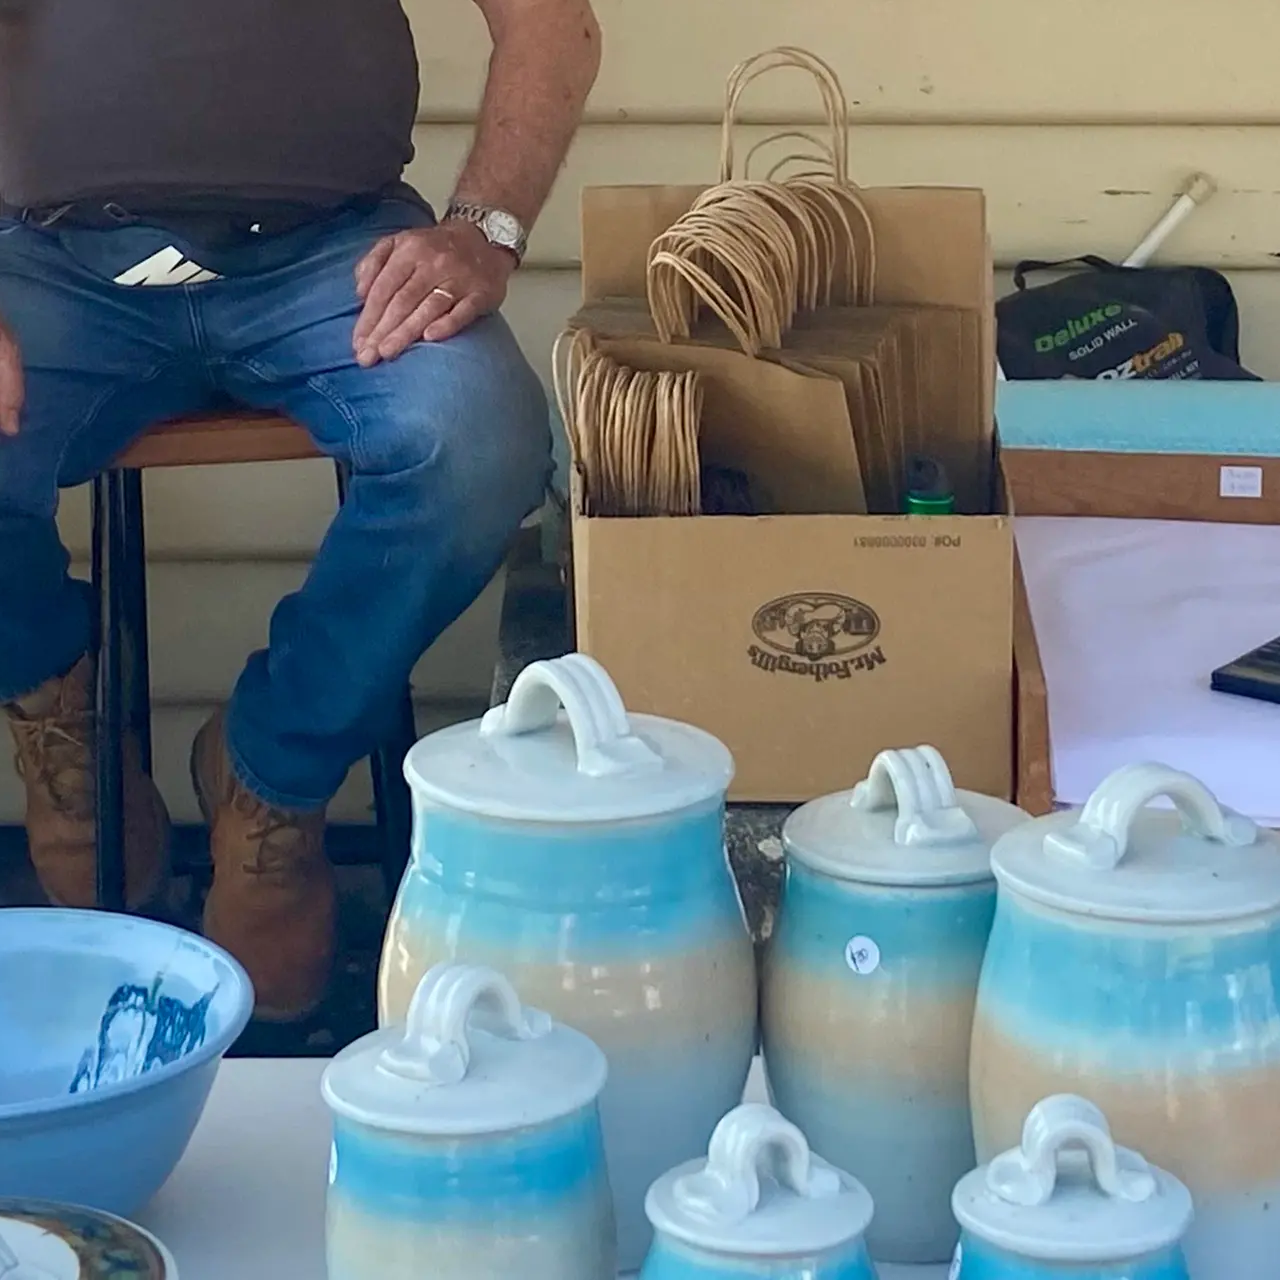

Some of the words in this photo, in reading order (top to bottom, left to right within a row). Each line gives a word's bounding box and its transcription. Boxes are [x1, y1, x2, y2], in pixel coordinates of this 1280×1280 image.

[1034, 303, 1122, 353] Deluxe
[1069, 335, 1104, 361] SOLID
[1103, 318, 1138, 341] WALL
